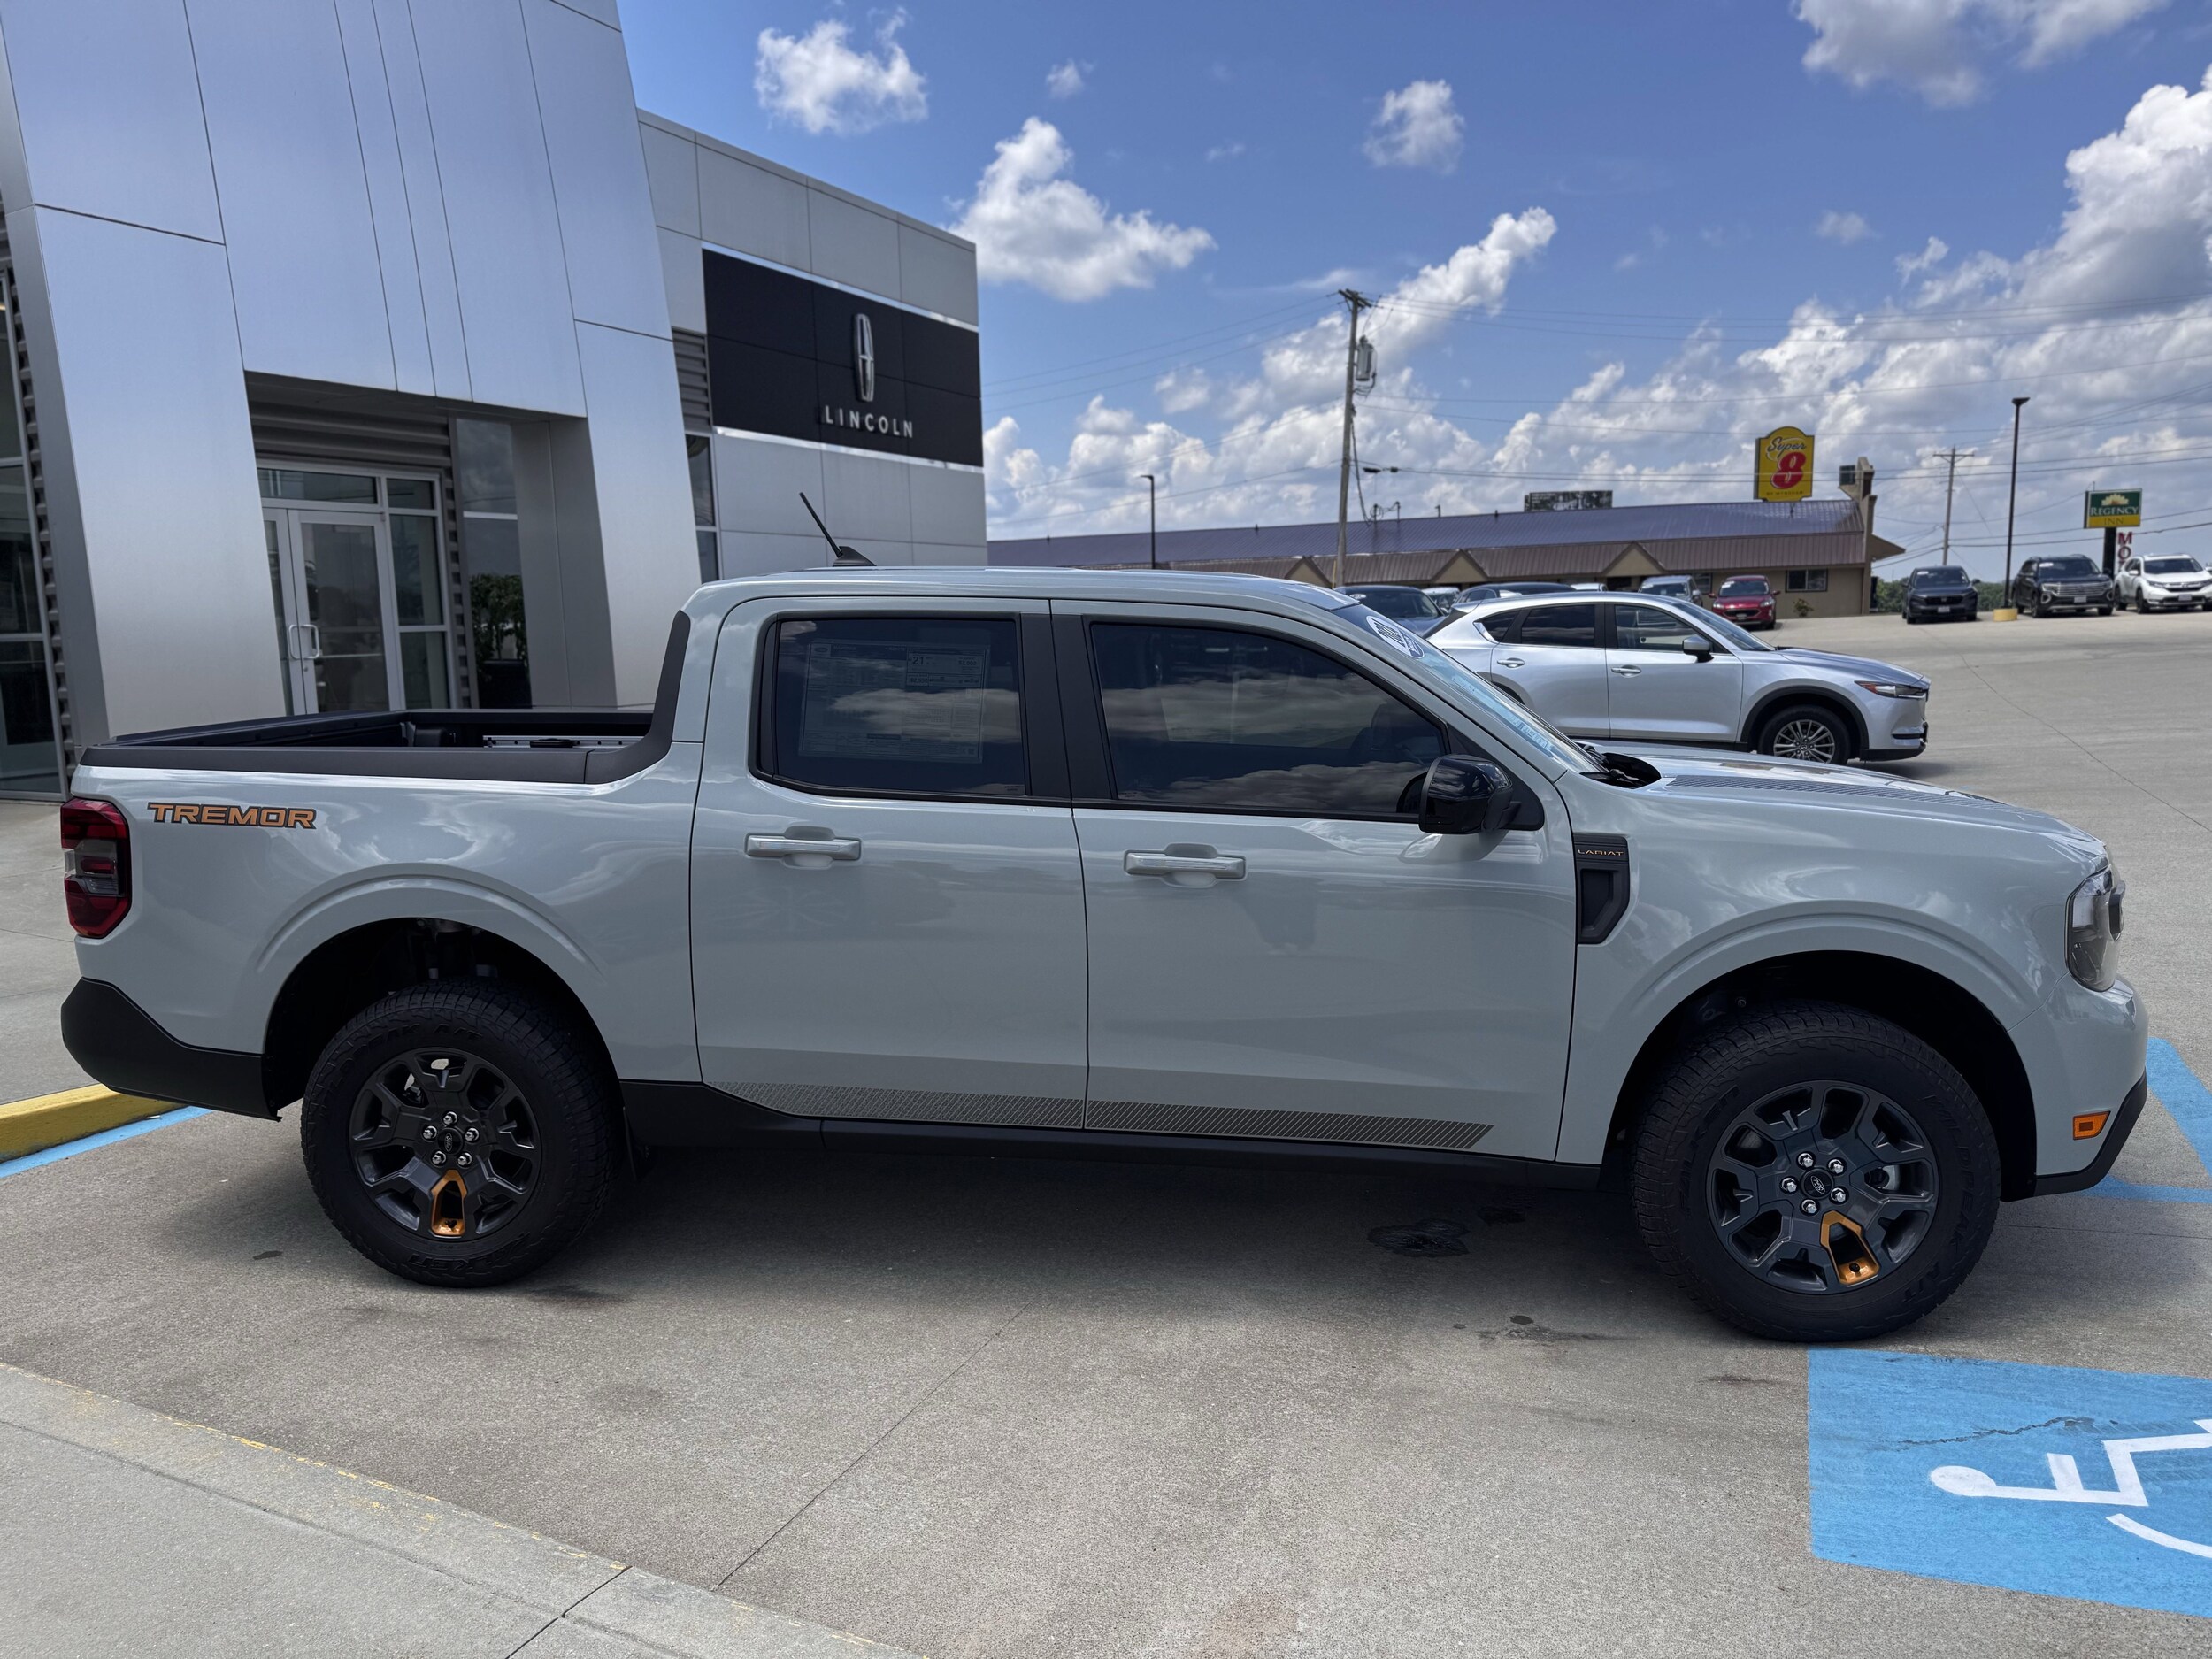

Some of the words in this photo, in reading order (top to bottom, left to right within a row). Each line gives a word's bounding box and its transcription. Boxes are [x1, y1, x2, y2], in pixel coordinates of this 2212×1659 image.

[825, 405, 914, 438] LINCOLN
[1767, 436, 1807, 458] Super
[1770, 452, 1806, 490] 8
[2090, 506, 2139, 517] REGENCY
[2104, 517, 2124, 526] INN
[912, 656, 924, 665] 21
[148, 802, 317, 830] TREMOR
